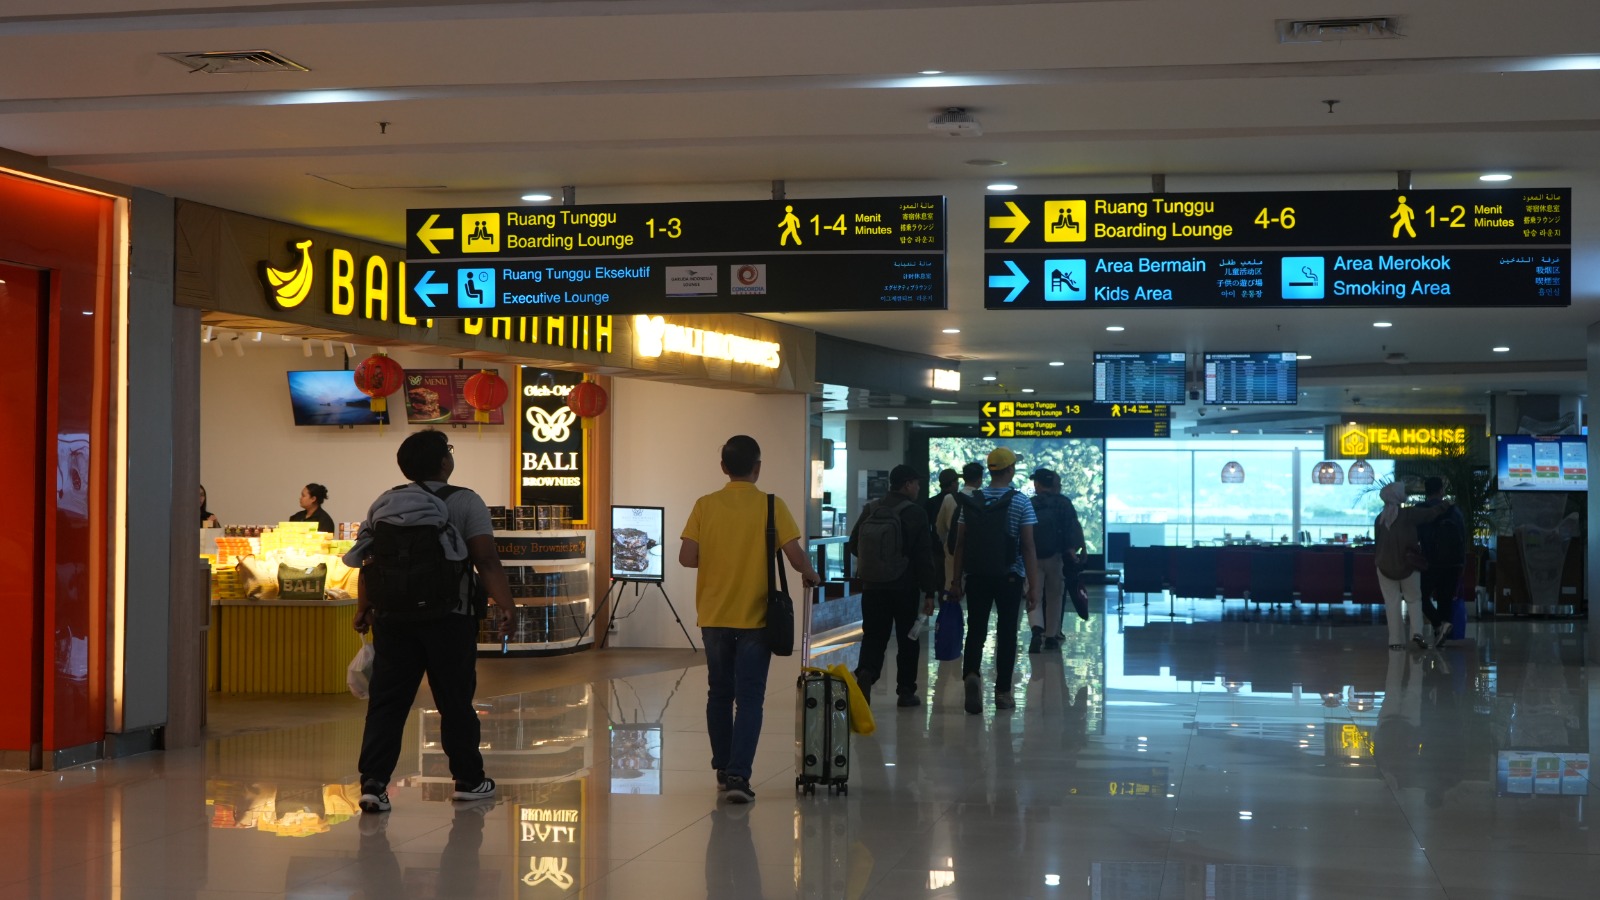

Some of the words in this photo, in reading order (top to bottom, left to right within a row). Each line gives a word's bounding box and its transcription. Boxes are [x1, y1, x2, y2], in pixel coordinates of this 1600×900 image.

[1095, 200, 1147, 217] Ruang
[1153, 199, 1213, 216] Tunggu
[1475, 205, 1502, 214] Menit
[508, 213, 555, 228] Ruang
[560, 211, 616, 227] Tunggu
[856, 214, 881, 222] Menit
[1255, 207, 1295, 229] 4-6
[1426, 205, 1465, 227] 1-2
[1475, 218, 1514, 226] Minutes
[646, 218, 681, 238] 1-3
[811, 214, 847, 235] 1-4
[856, 226, 892, 234] Minutes
[1095, 223, 1166, 240] Boarding
[1173, 223, 1232, 240] Lounge
[508, 234, 573, 250] Boarding
[579, 233, 633, 249] Lounge
[1095, 259, 1133, 272] Area
[1139, 258, 1205, 272] Bermain
[1334, 256, 1373, 270] Area
[1379, 256, 1450, 270] Merokok
[503, 269, 541, 282] Ruang
[546, 268, 590, 281] Tunggu
[596, 267, 650, 278] Eksekutif
[332, 249, 433, 329] BAL
[1095, 287, 1129, 300] Kids
[1135, 287, 1172, 300] Area
[1334, 281, 1405, 298] Smoking
[1411, 281, 1450, 294] Area
[504, 293, 560, 303] Executive
[565, 292, 609, 305] Lounge
[1015, 401, 1035, 409] Ruang
[1066, 405, 1080, 413] 1-3
[1123, 405, 1137, 413] 1-4
[1065, 425, 1072, 434] 4
[1367, 428, 1400, 443] TEA
[1403, 428, 1465, 443] HOUSE
[1389, 445, 1419, 455] kedai
[523, 452, 578, 470] BALI
[523, 477, 580, 486] BROWNIES
[495, 542, 527, 556] udgy
[283, 580, 320, 592] BALI
